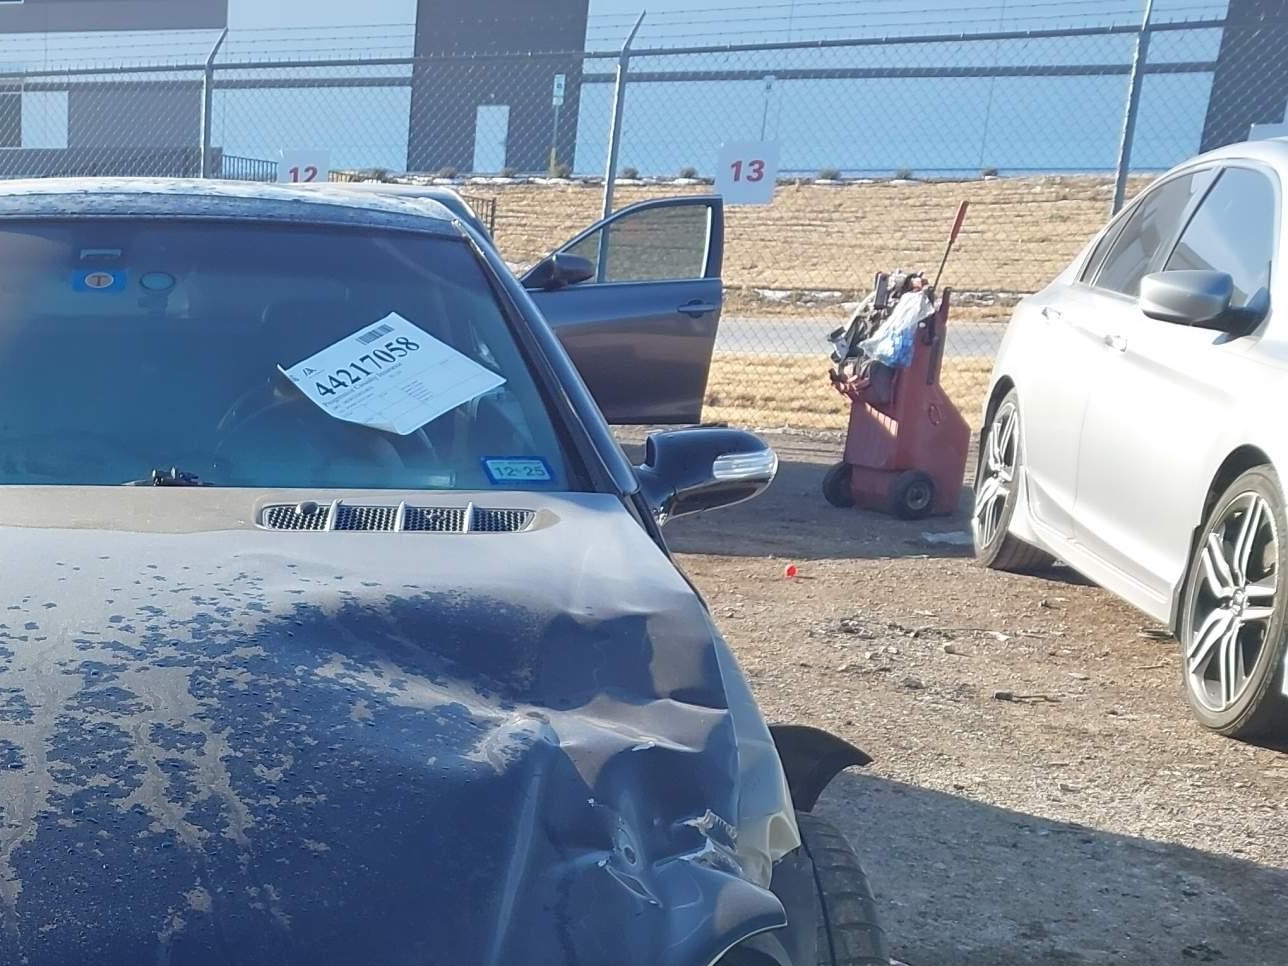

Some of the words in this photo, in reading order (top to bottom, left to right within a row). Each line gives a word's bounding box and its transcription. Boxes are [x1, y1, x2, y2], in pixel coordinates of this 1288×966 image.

[289, 166, 318, 183] 12
[730, 159, 766, 182] 13
[315, 336, 420, 397] 44217058
